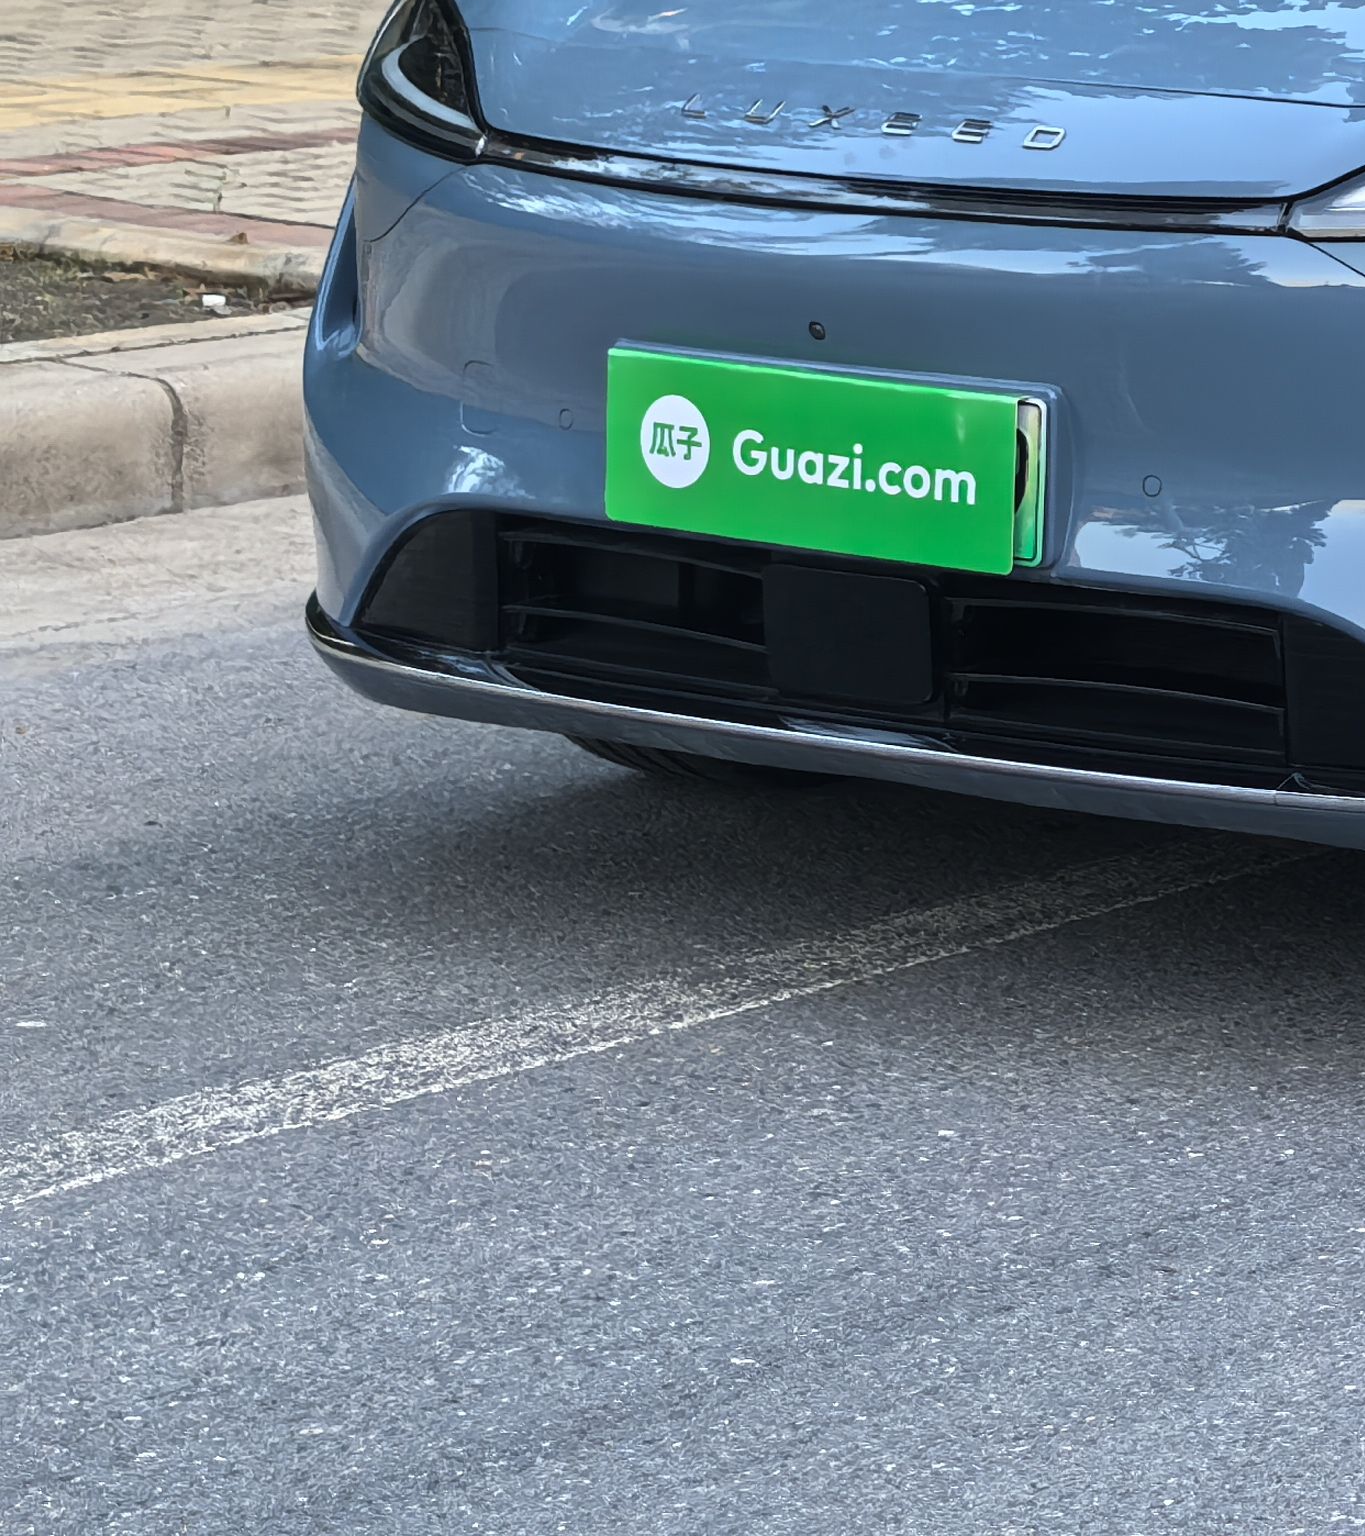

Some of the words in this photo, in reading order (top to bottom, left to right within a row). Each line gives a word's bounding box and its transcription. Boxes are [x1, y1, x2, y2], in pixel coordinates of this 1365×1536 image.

[681, 94, 1067, 150] LUXEED
[649, 421, 702, 461] 瓜子
[732, 429, 977, 505] Guazi.com
